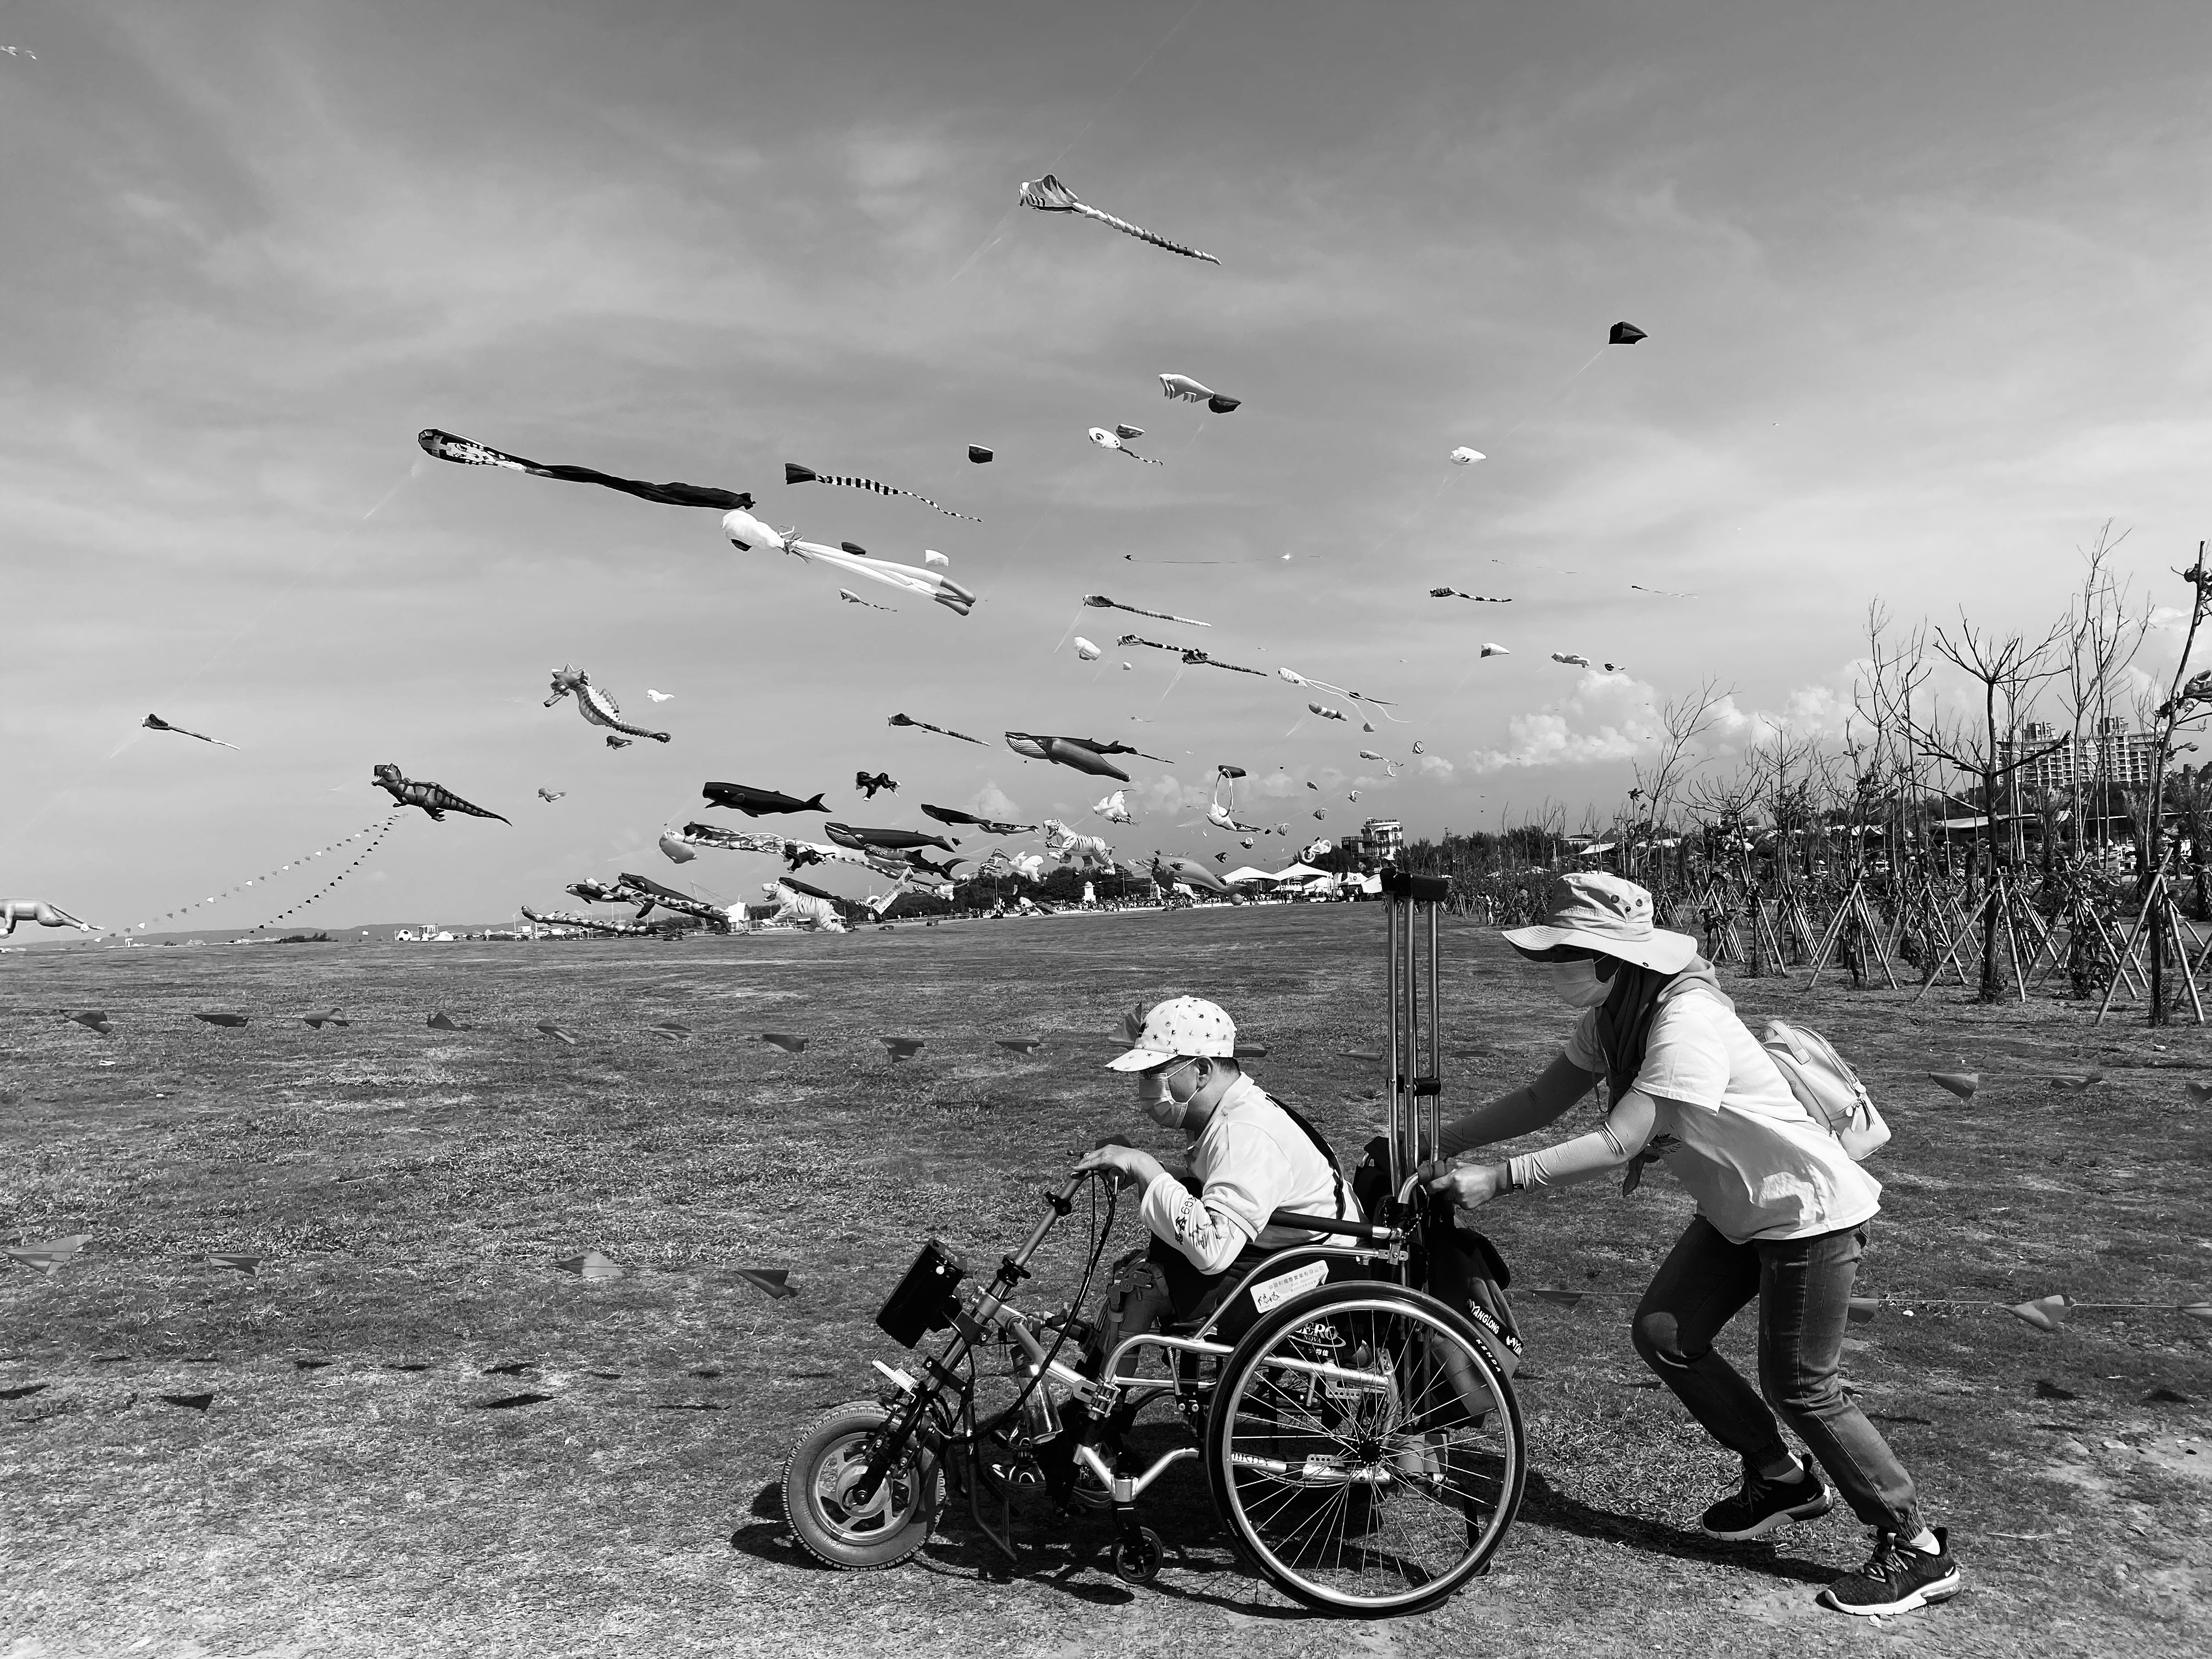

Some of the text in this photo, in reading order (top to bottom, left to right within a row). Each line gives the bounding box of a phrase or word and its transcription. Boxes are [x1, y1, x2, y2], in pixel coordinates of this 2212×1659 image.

[1471, 1301, 1499, 1334] YANGLONG
[1304, 1334, 1322, 1344] NOVA
[1476, 1339, 1502, 1372] KENDA
